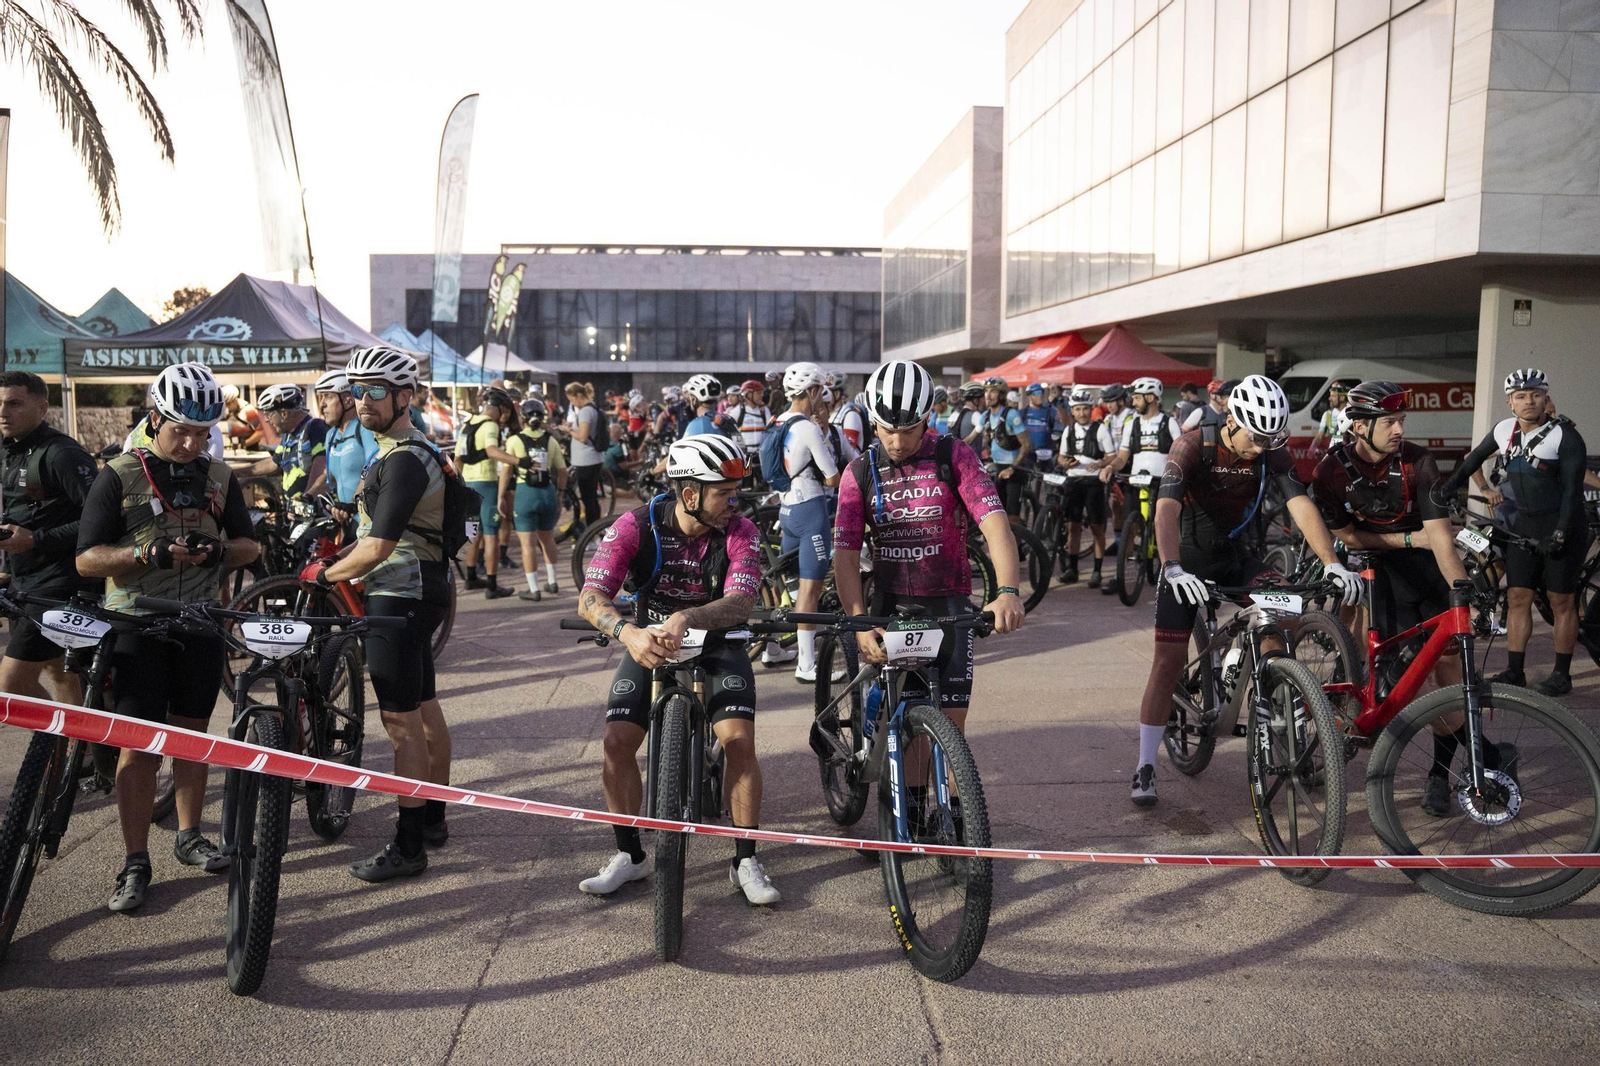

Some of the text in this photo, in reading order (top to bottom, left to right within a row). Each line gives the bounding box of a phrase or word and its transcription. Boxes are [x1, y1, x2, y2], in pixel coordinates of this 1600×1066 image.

[81, 346, 312, 367] ASISTENCIAS WILLY
[1447, 387, 1474, 408] Ca
[870, 486, 943, 506] ARCADIA
[811, 534, 828, 561] GOBIK
[1465, 533, 1482, 545] 356
[880, 543, 943, 561] mongar
[1264, 595, 1291, 603] 438
[48, 622, 98, 636] FRANCISCO MIGUEL
[59, 612, 96, 628] 387
[259, 623, 295, 635] 386
[904, 631, 924, 647] 87
[1258, 722, 1270, 750] FOX
[890, 904, 913, 951] MAXXIS
